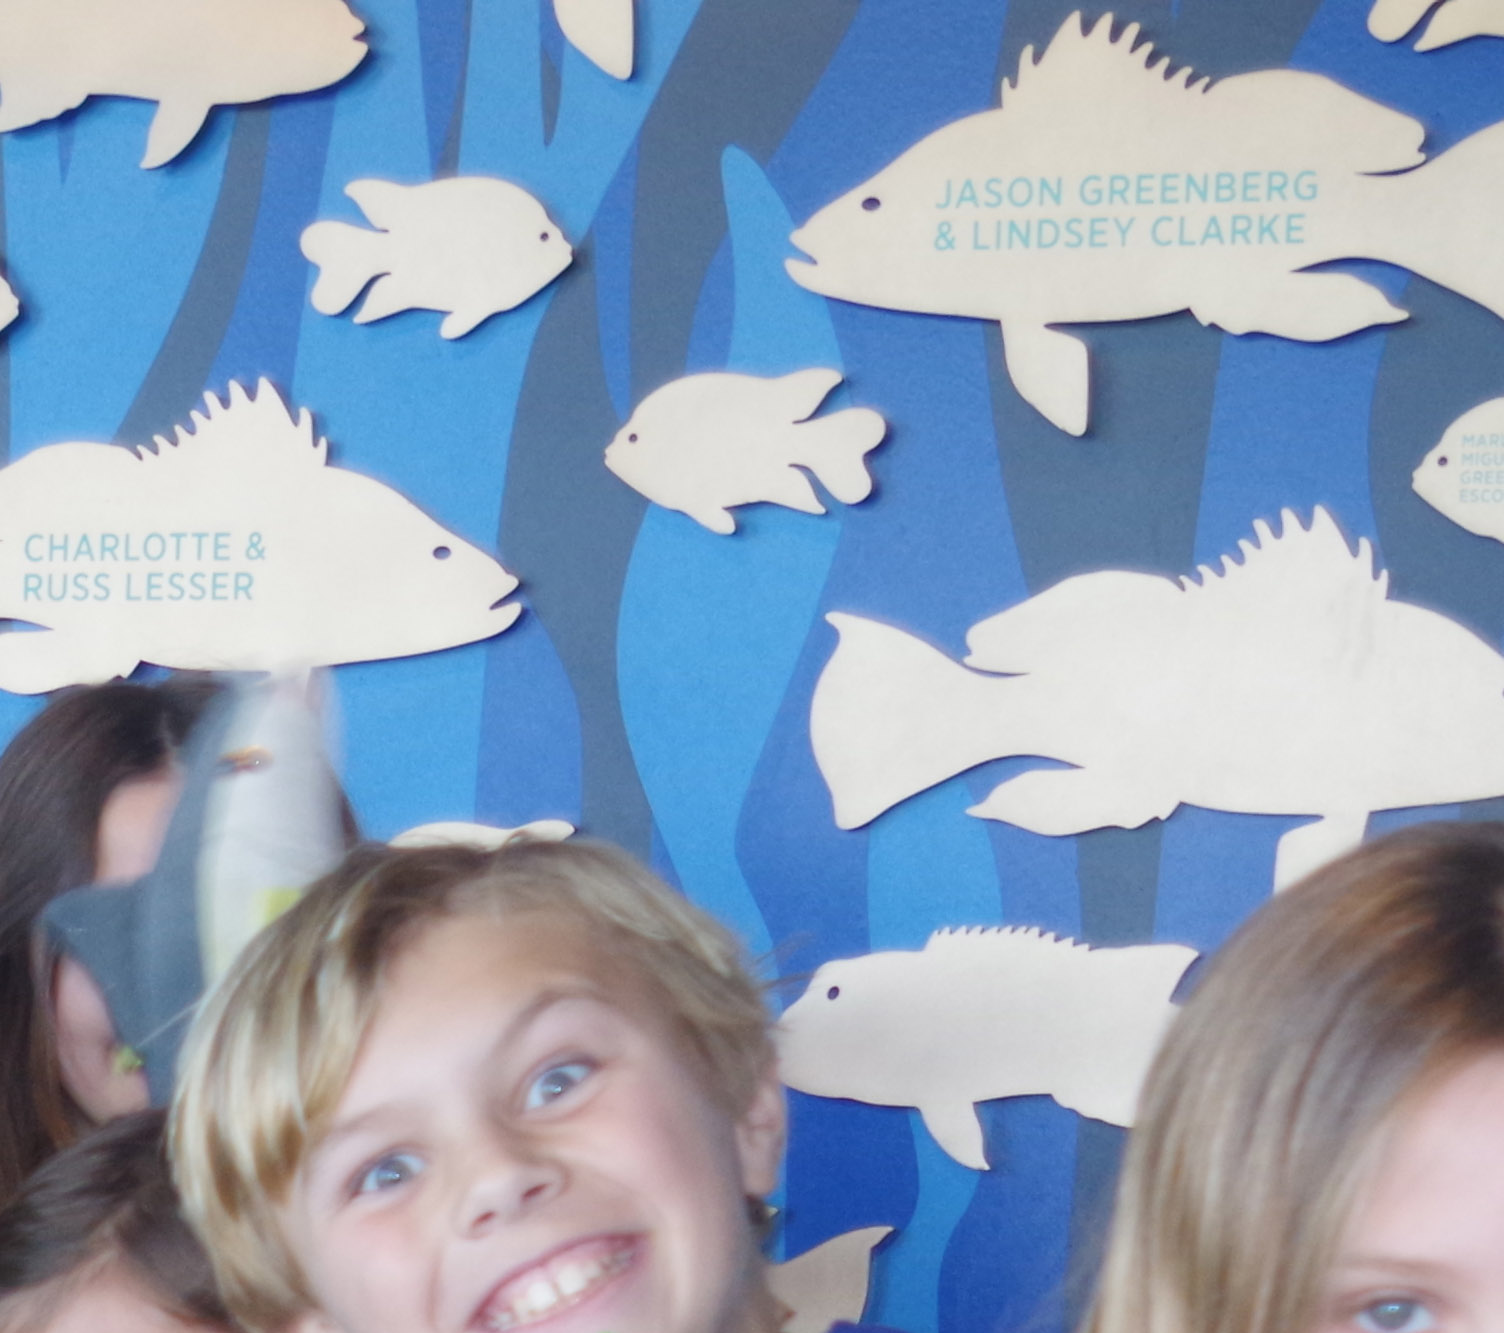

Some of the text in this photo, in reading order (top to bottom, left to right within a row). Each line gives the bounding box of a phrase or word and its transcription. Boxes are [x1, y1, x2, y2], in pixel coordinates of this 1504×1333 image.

[934, 170, 1320, 209] JASON GREENBERG
[933, 213, 1307, 251] & LINDSEY CLARKE
[24, 532, 266, 562] CHARLOTTE &
[22, 572, 254, 602] RUSS LESSER
